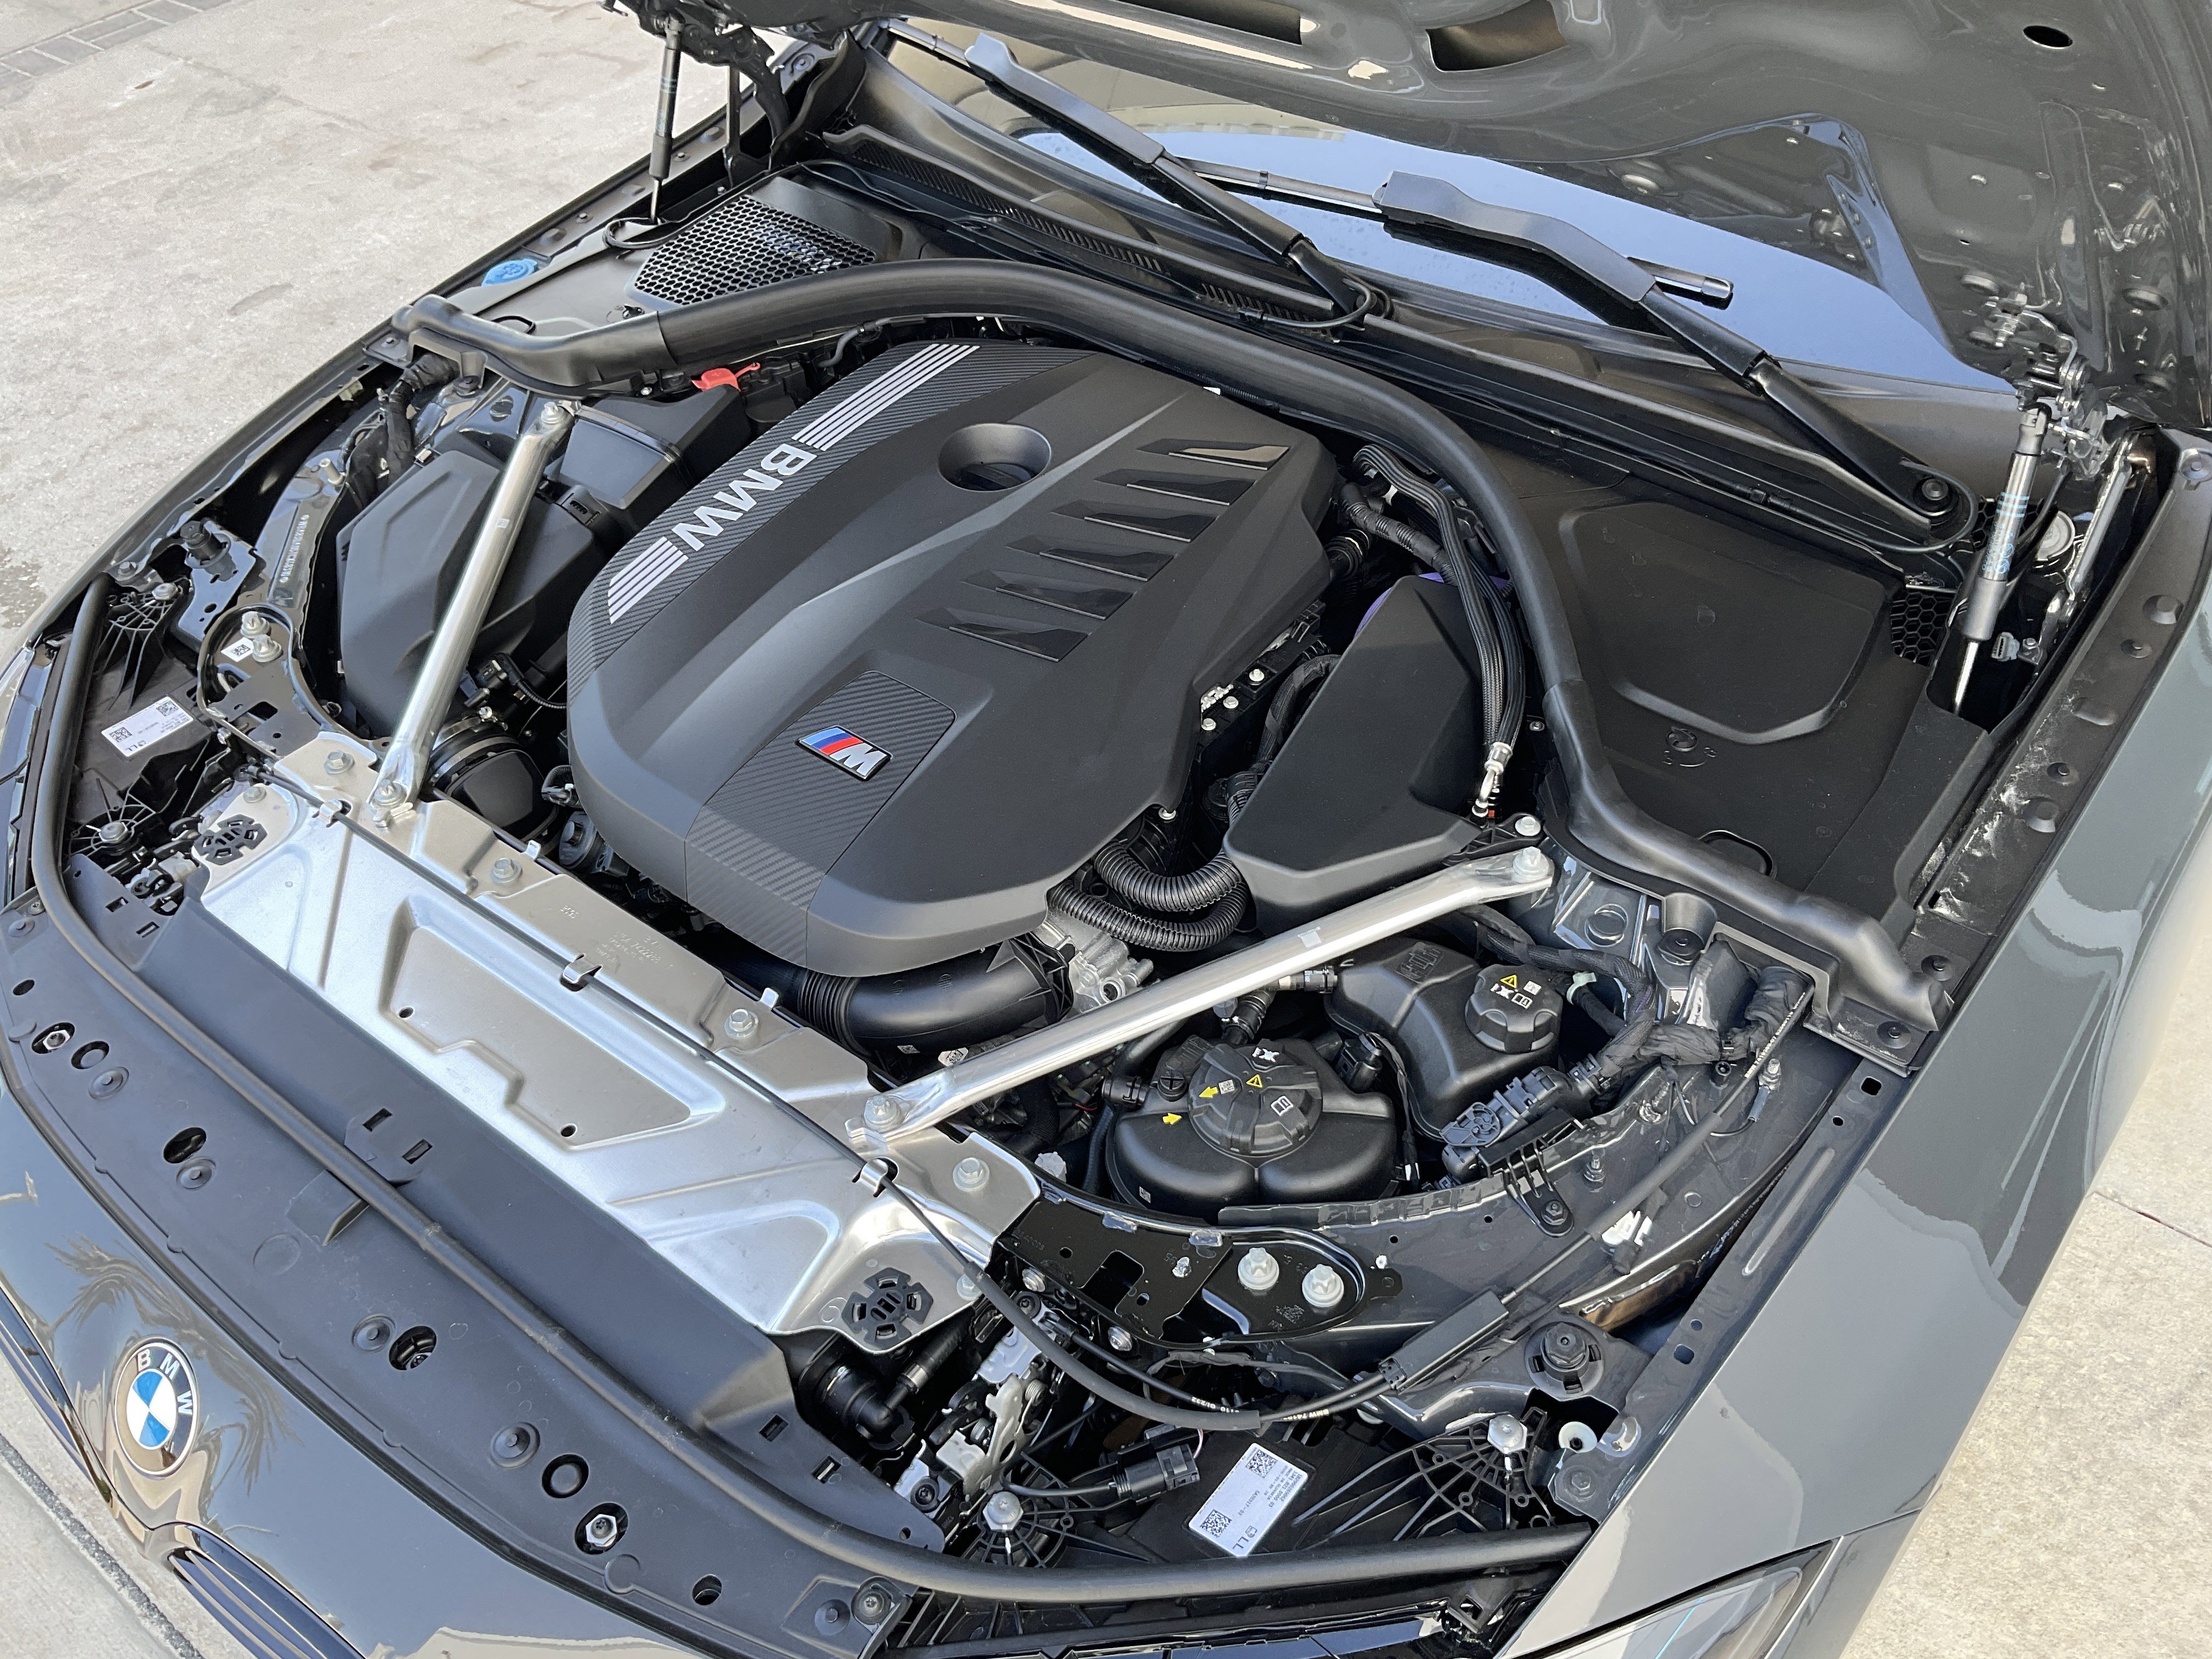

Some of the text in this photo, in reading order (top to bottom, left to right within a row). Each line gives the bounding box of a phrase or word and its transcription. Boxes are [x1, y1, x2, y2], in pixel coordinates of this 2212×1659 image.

[672, 443, 817, 551] BMW
[138, 1348, 193, 1415] BMW
[1308, 1409, 1330, 1419] BMW
[1232, 1536, 1250, 1550] LL
